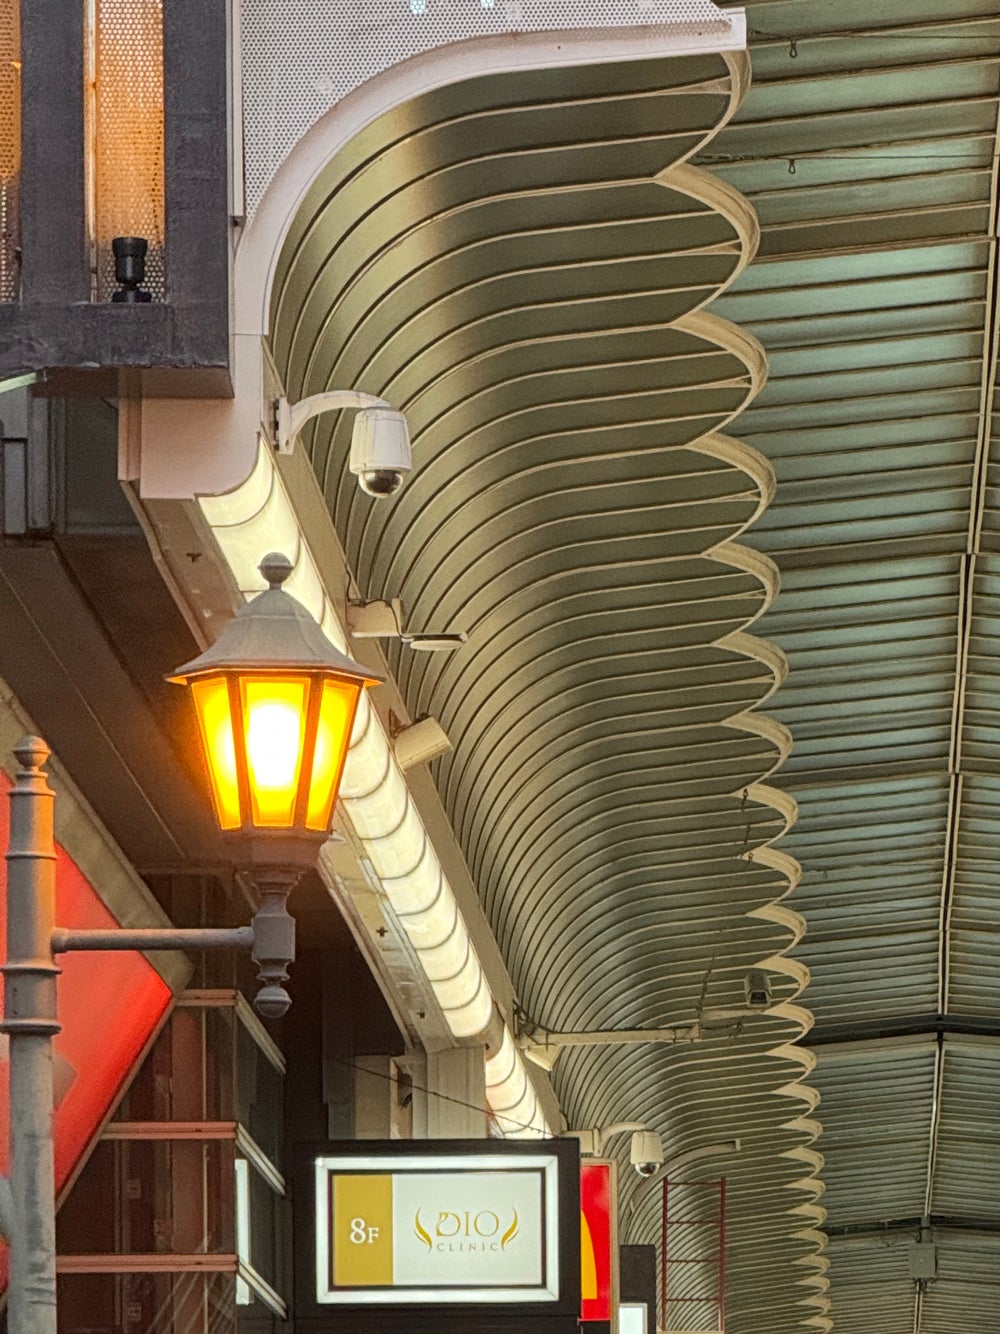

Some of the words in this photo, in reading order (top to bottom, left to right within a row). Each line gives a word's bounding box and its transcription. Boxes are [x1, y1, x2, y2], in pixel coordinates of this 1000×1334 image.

[350, 1218, 380, 1244] 8F
[435, 1210, 500, 1238] DIO
[436, 1242, 498, 1252] CLINIC
